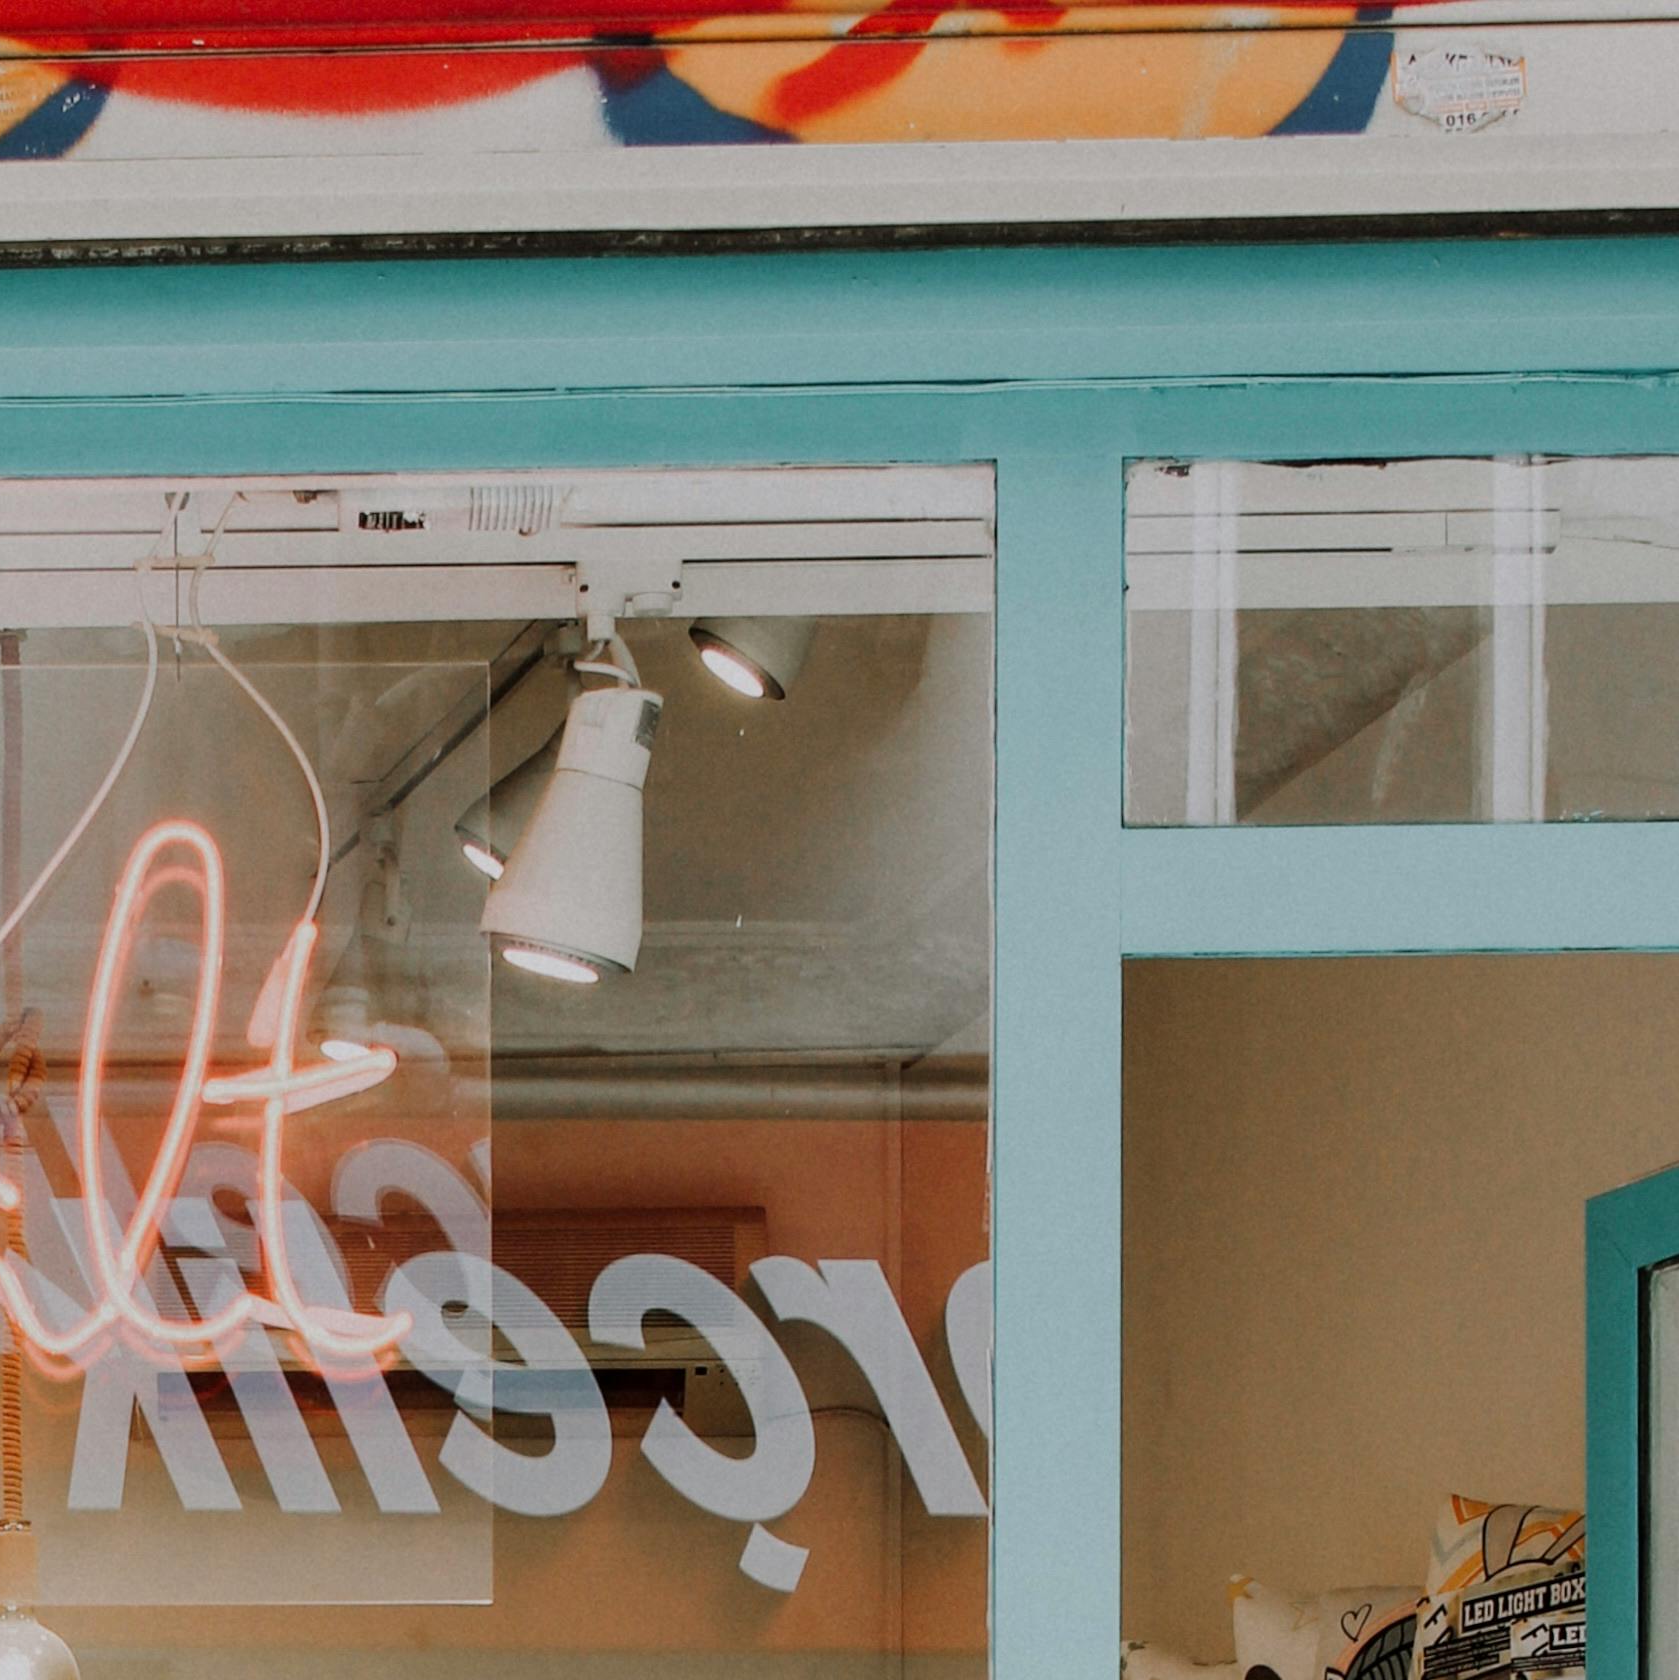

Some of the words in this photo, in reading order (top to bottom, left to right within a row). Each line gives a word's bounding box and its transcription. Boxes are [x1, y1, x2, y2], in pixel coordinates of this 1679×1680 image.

[1464, 1599, 1494, 1628] LED
[1497, 1585, 1547, 1621] LIGHT
[1550, 1576, 1585, 1607] BOX
